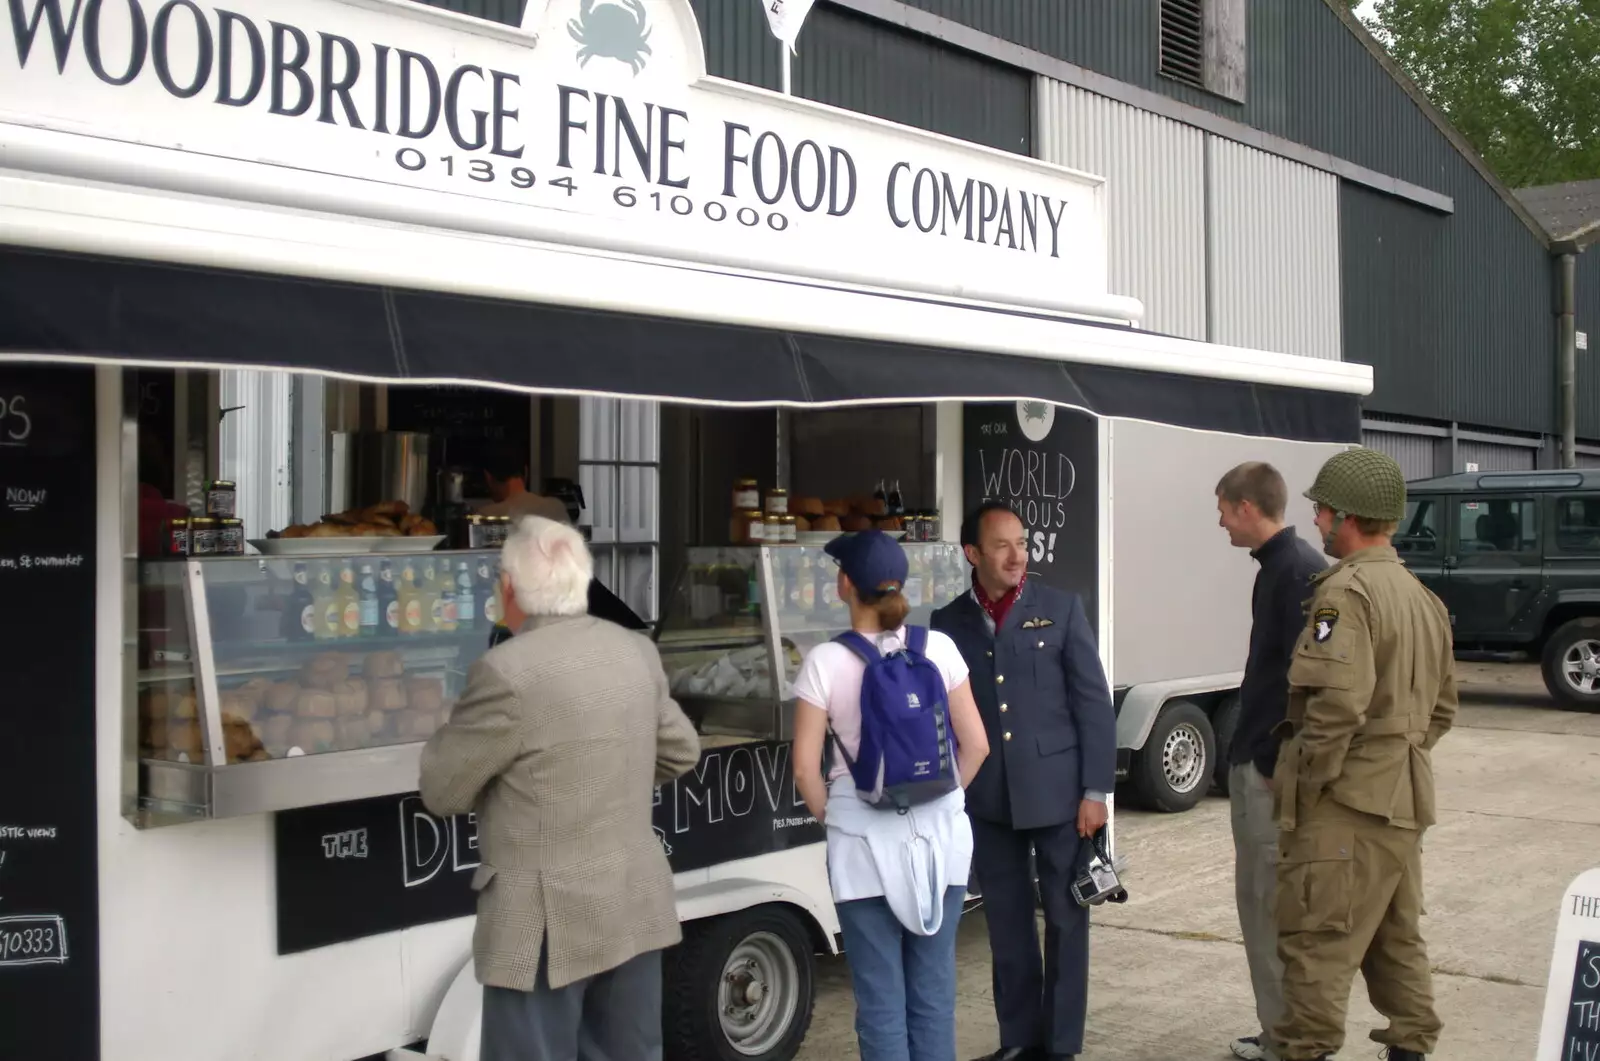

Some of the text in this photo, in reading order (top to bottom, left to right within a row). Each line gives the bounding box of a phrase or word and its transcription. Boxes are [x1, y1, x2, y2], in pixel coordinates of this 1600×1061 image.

[8, 0, 1068, 258] WOODBRIDGE FINE FOOD COMPANY
[395, 147, 790, 231] 01394 610000
[979, 449, 1076, 500] WORLD
[6, 488, 47, 503] NOW!
[982, 497, 1066, 528] MOUS
[321, 827, 368, 858] THE
